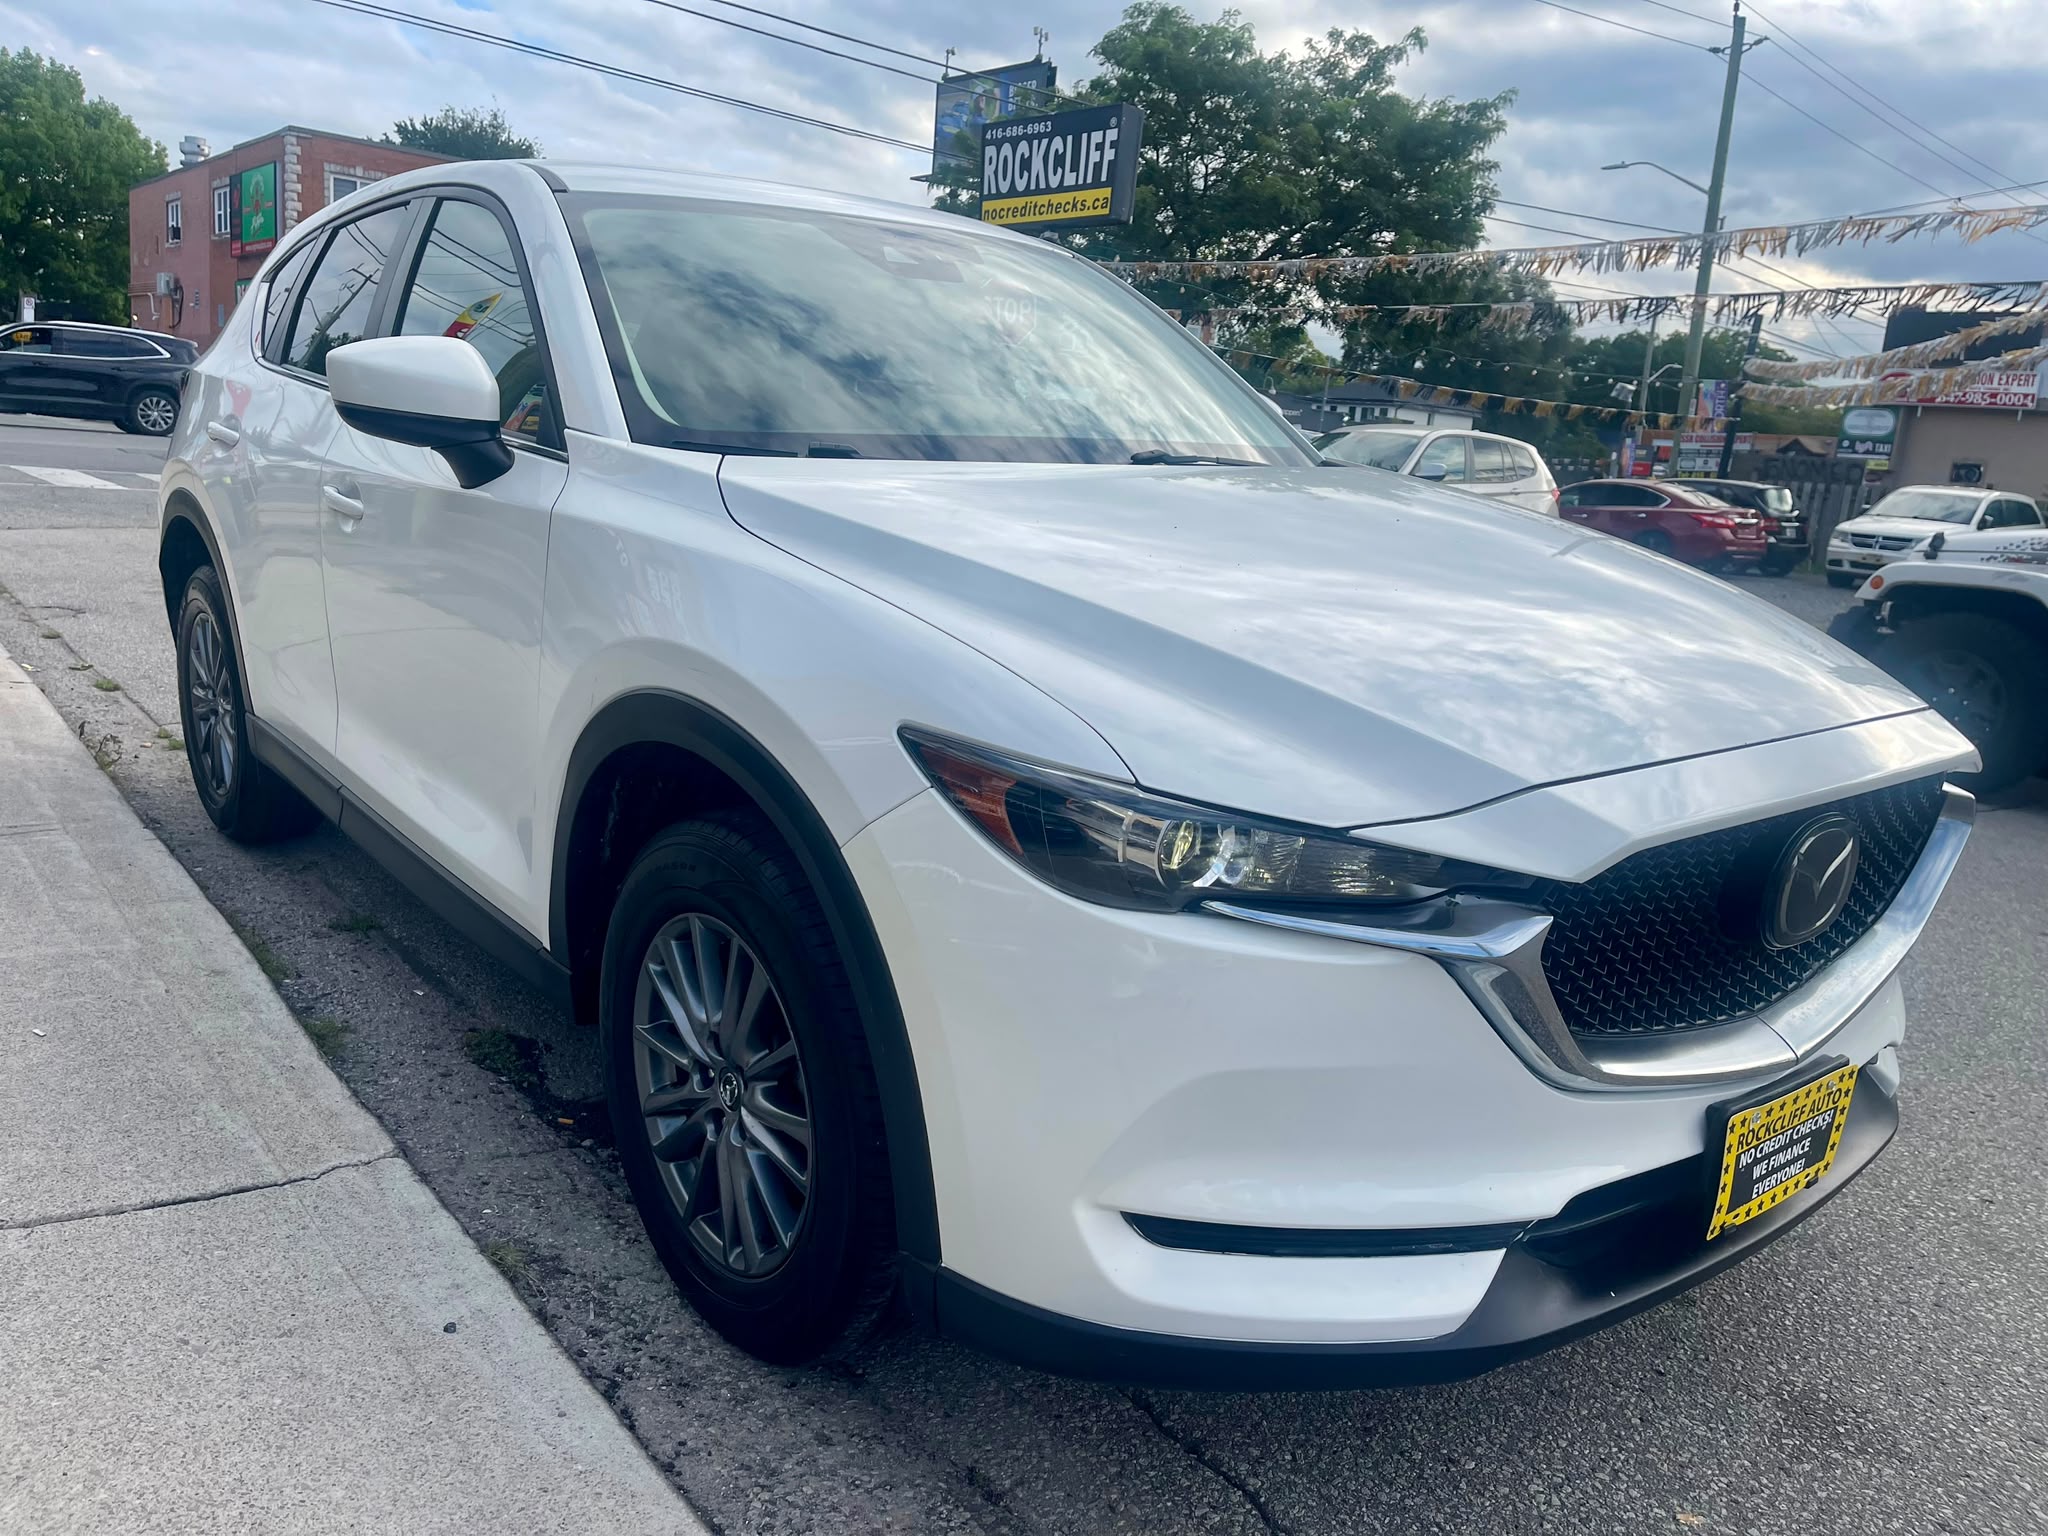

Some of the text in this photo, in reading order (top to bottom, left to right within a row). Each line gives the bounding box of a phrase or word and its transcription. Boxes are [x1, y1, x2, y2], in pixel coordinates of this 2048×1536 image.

[985, 120, 1052, 140] 416-686-6963
[983, 127, 1119, 195] ROCKCLIFF
[983, 195, 1109, 221] nocreditchecks.ca
[1997, 373, 2037, 387] EXPERT
[1875, 443, 1891, 453] TAXI
[1736, 1088, 1842, 1152] ROCKCLIFF AUTO
[1739, 1109, 1835, 1169] NO CREDIT CHECKS!
[1751, 1157, 1806, 1200] EVERYONE!
[1753, 1137, 1812, 1180] WE FINANCE
